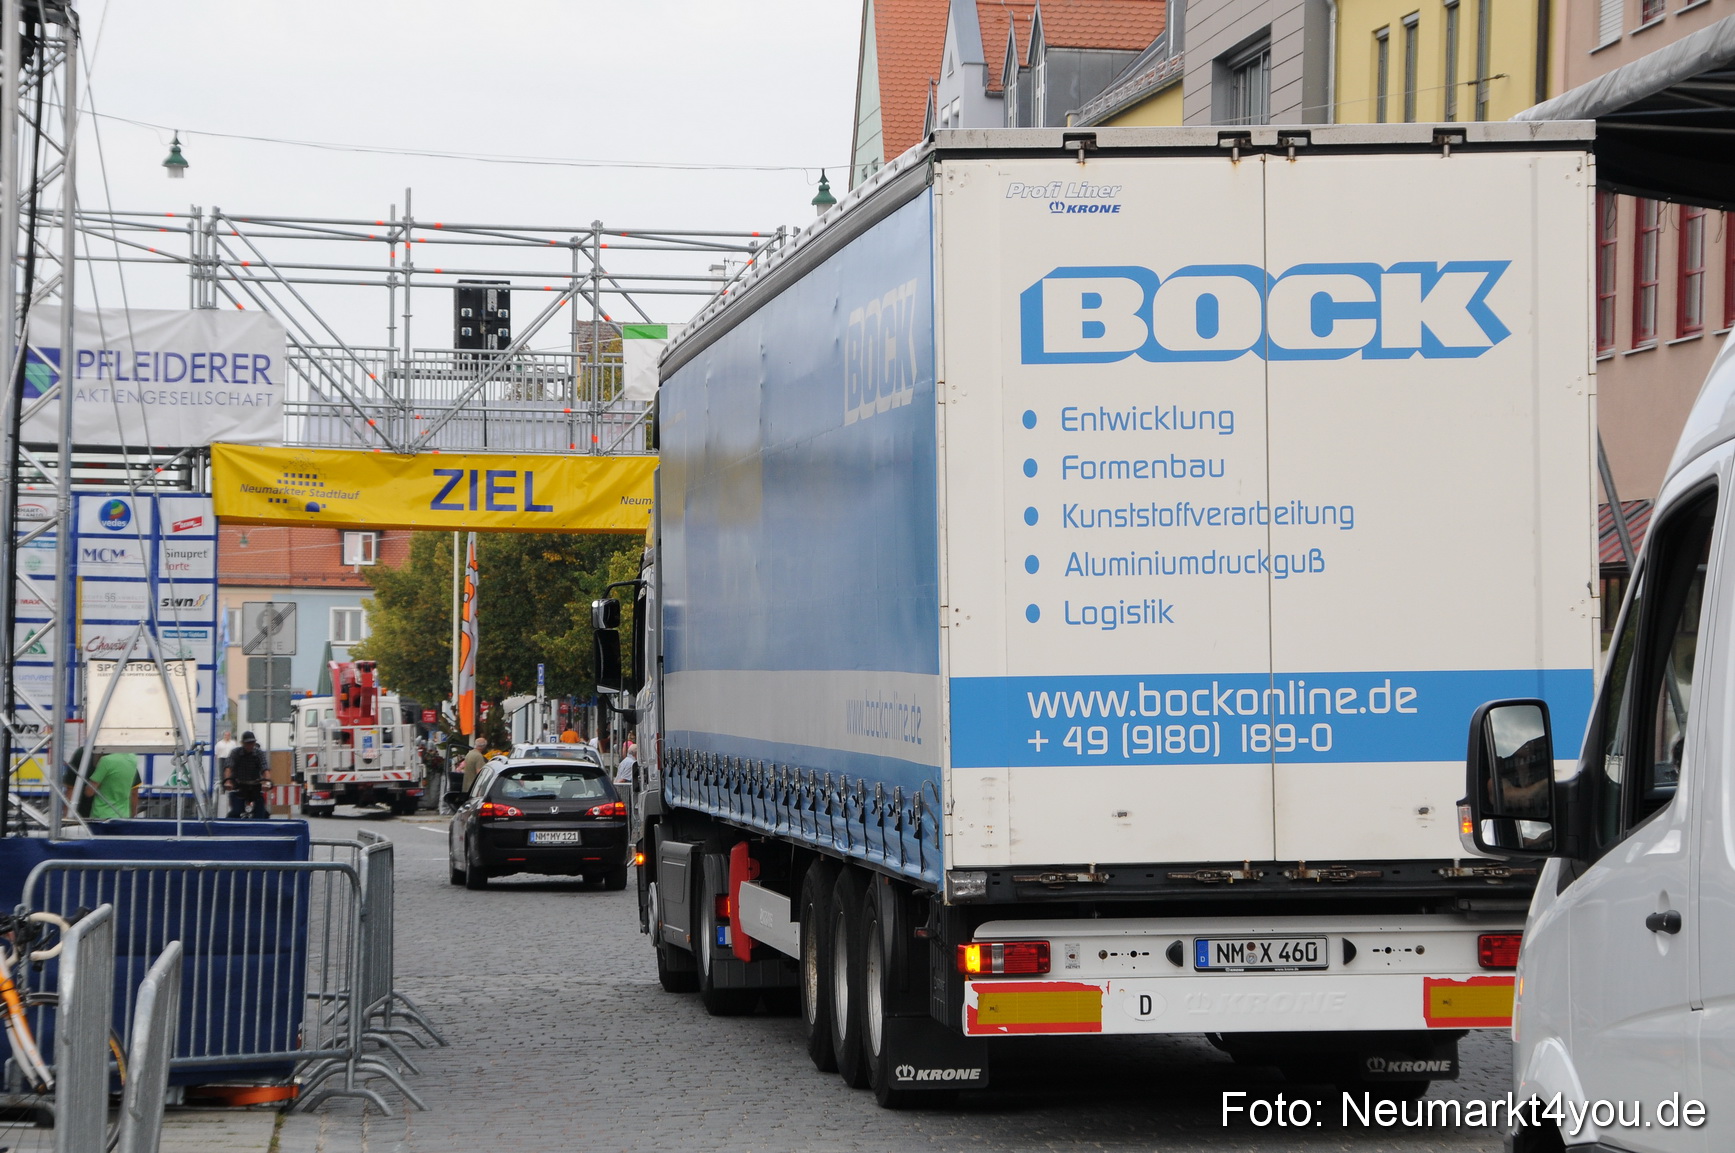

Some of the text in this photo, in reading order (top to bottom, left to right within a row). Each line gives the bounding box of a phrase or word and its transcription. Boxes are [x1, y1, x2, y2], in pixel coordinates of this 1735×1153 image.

[1006, 181, 1122, 198] Profi Liner
[1066, 204, 1121, 214] KRONE
[1020, 260, 1512, 364] BOCK
[844, 278, 918, 426] BOCK
[76, 350, 273, 385] PFLEIDERER
[75, 388, 273, 407] AKTIENGESELLSCHAFT
[1061, 405, 1234, 435] Entwicklung
[1062, 454, 1225, 480] Formenbau
[240, 483, 360, 500] Neumarkter Stadtlauf
[430, 468, 553, 512] ZIEL
[620, 496, 653, 505] Neum
[102, 519, 126, 527] vedes
[1063, 500, 1354, 530] Kunststoffverarbeitung
[82, 548, 125, 562] MCM
[165, 549, 207, 560] Sinupret
[1064, 548, 1326, 579] Aluminiumdruckguß
[160, 598, 194, 607] swn
[1064, 599, 1174, 630] Logistik
[1028, 679, 1418, 718] www.bockonline.de
[846, 689, 922, 745] www.bockonline.de
[1062, 726, 1108, 755] 49
[1122, 722, 1220, 758] (9180)
[1241, 723, 1332, 753] 189-0
[562, 832, 577, 841] 121
[1216, 941, 1318, 963] NM X 460
[1140, 994, 1152, 1015] D
[916, 1067, 981, 1080] KRONE
[1387, 1060, 1451, 1073] KRONE
